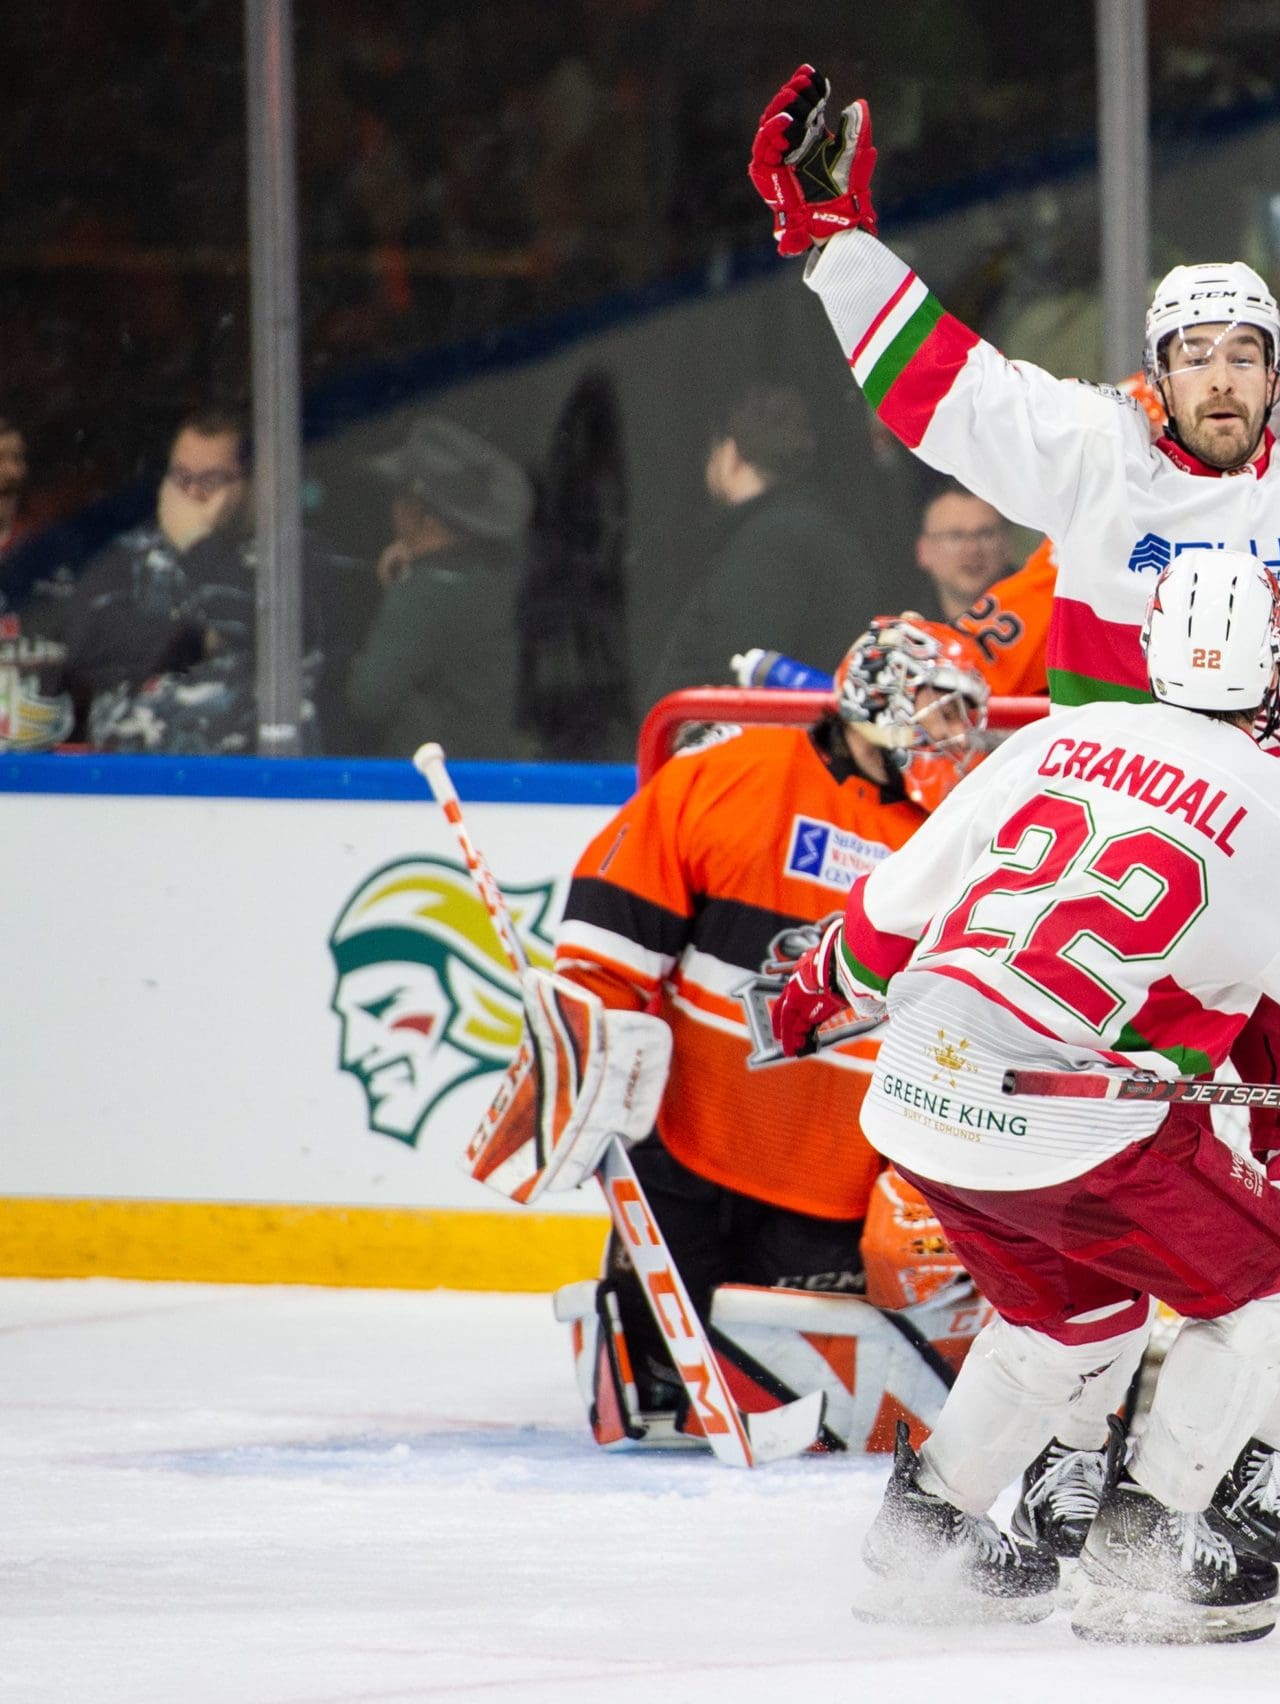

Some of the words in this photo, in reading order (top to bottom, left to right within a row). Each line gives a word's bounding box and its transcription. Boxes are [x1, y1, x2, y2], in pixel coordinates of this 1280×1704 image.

[812, 211, 851, 226] CCM
[1189, 290, 1238, 301] CCM
[1191, 648, 1222, 669] 22
[1037, 738, 1249, 859] CRANDALL
[917, 788, 1209, 1036] 22
[882, 1073, 952, 1120] GREENE
[958, 1102, 1030, 1137] KING
[903, 1107, 924, 1124] BURY
[934, 1121, 982, 1144] EDMUNDS
[611, 1180, 731, 1434] CCM
